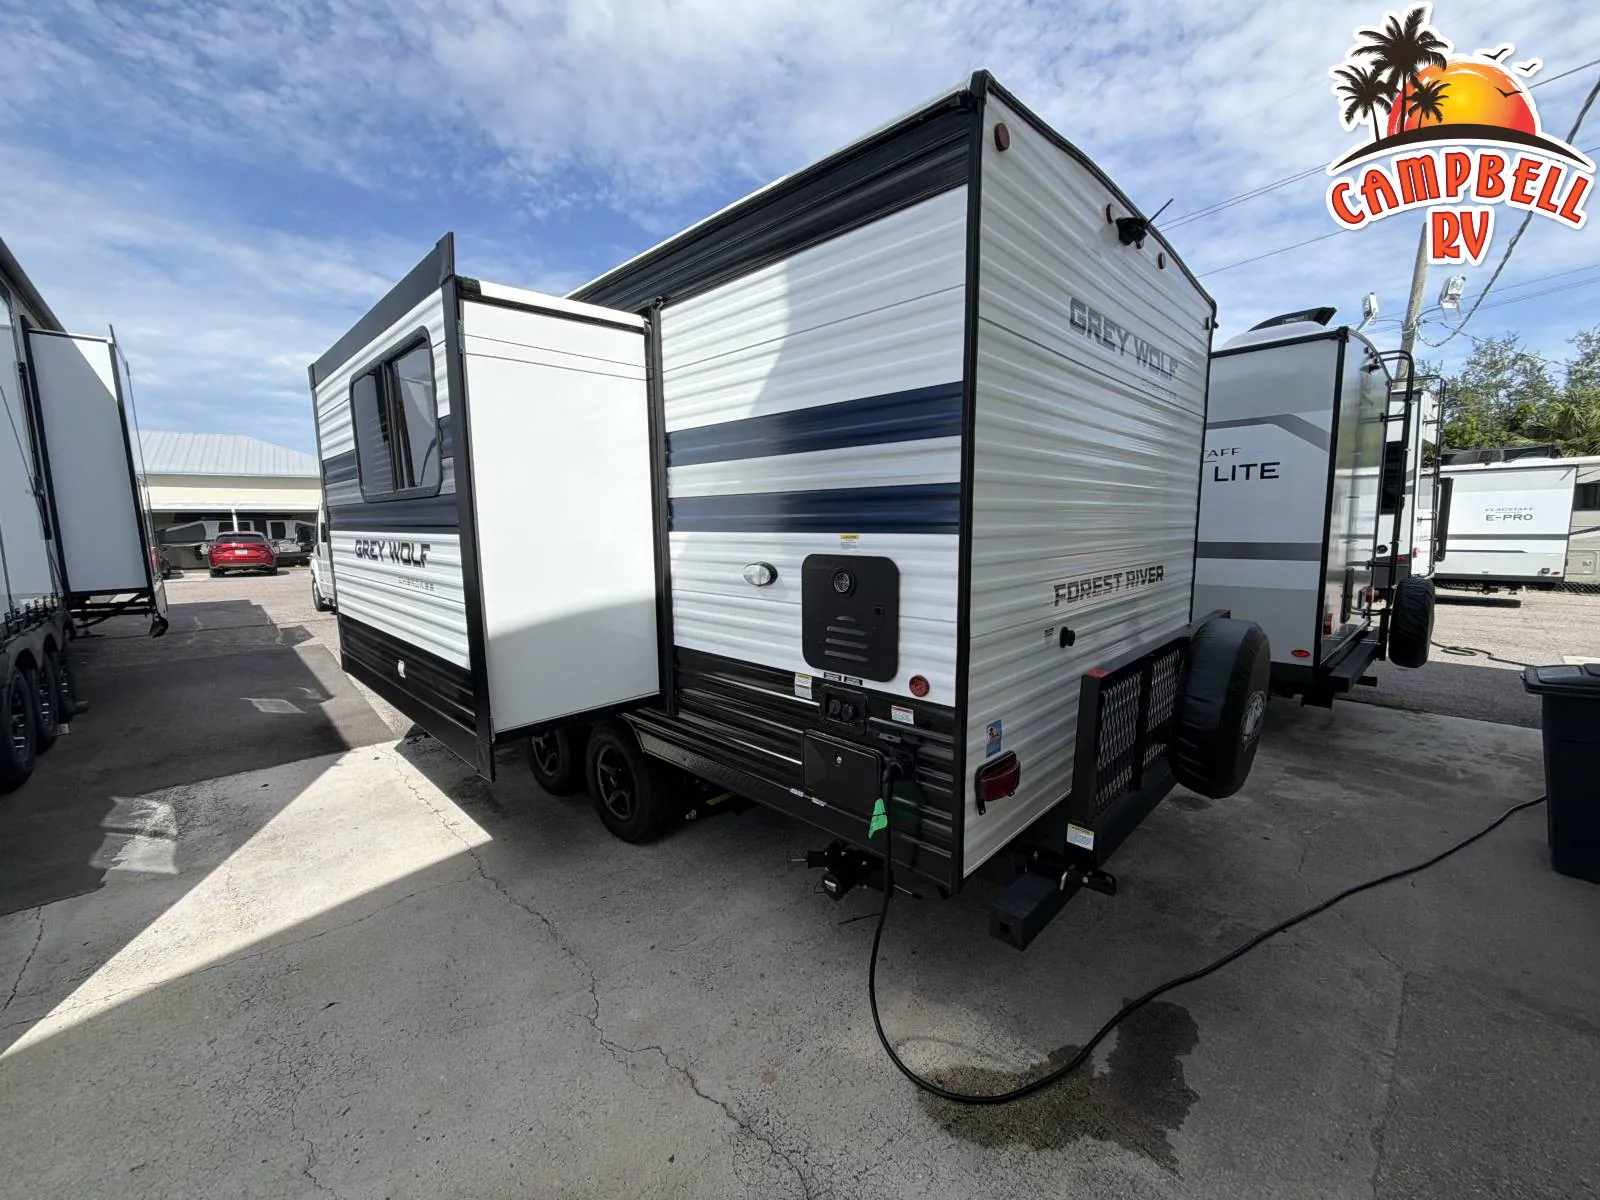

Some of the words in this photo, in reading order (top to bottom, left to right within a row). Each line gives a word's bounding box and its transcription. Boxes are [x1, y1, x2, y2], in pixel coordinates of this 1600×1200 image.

[1069, 297, 1130, 356] GREY
[1133, 335, 1178, 381] WOLF
[1203, 447, 1241, 458] AFF
[1213, 461, 1281, 482] LITE
[1485, 513, 1533, 521] E-PRO
[354, 539, 385, 562] GREY
[388, 540, 431, 568] WOLF
[1053, 573, 1123, 607] FOREST
[1125, 565, 1164, 589] RIVER
